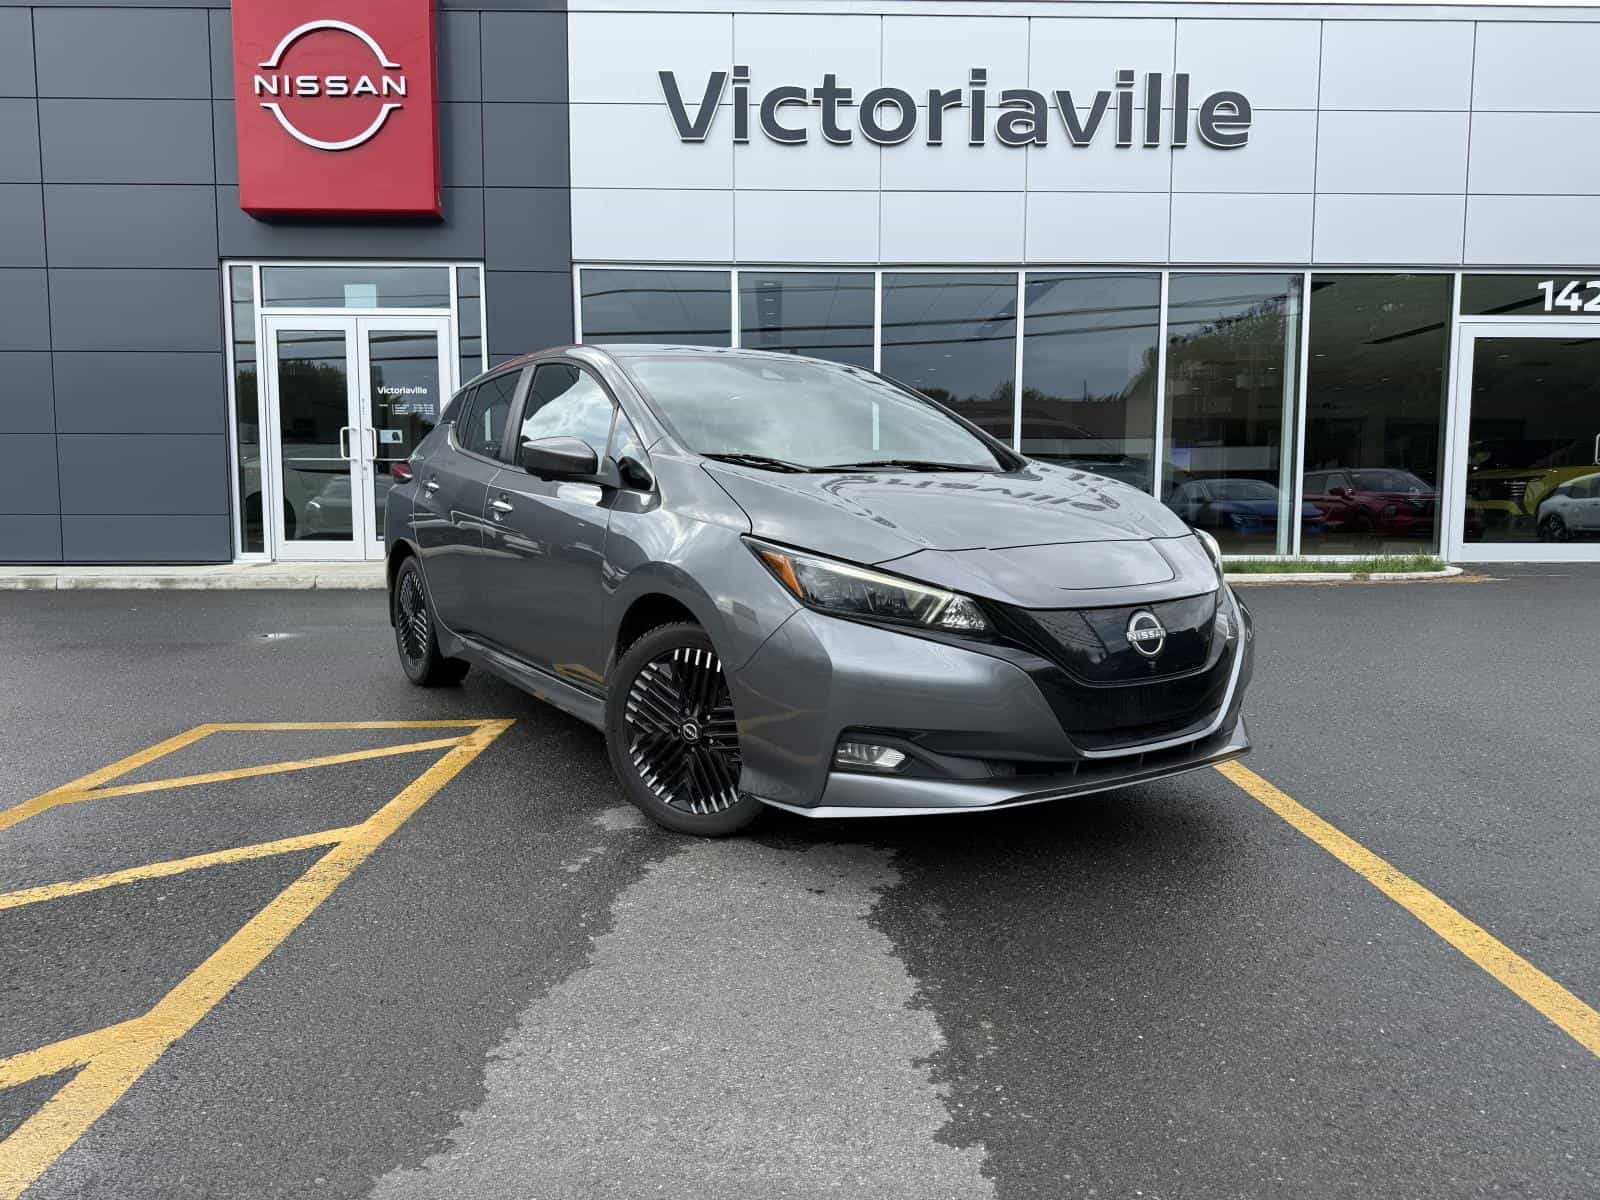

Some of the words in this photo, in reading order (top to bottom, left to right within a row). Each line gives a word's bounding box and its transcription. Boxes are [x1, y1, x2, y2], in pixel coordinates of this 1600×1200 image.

[254, 75, 406, 96] NISSAN
[658, 65, 1253, 148] Victoriaville
[1537, 280, 1600, 311] 142
[377, 385, 427, 394] Victoriaville
[1127, 629, 1166, 641] NISSAN
